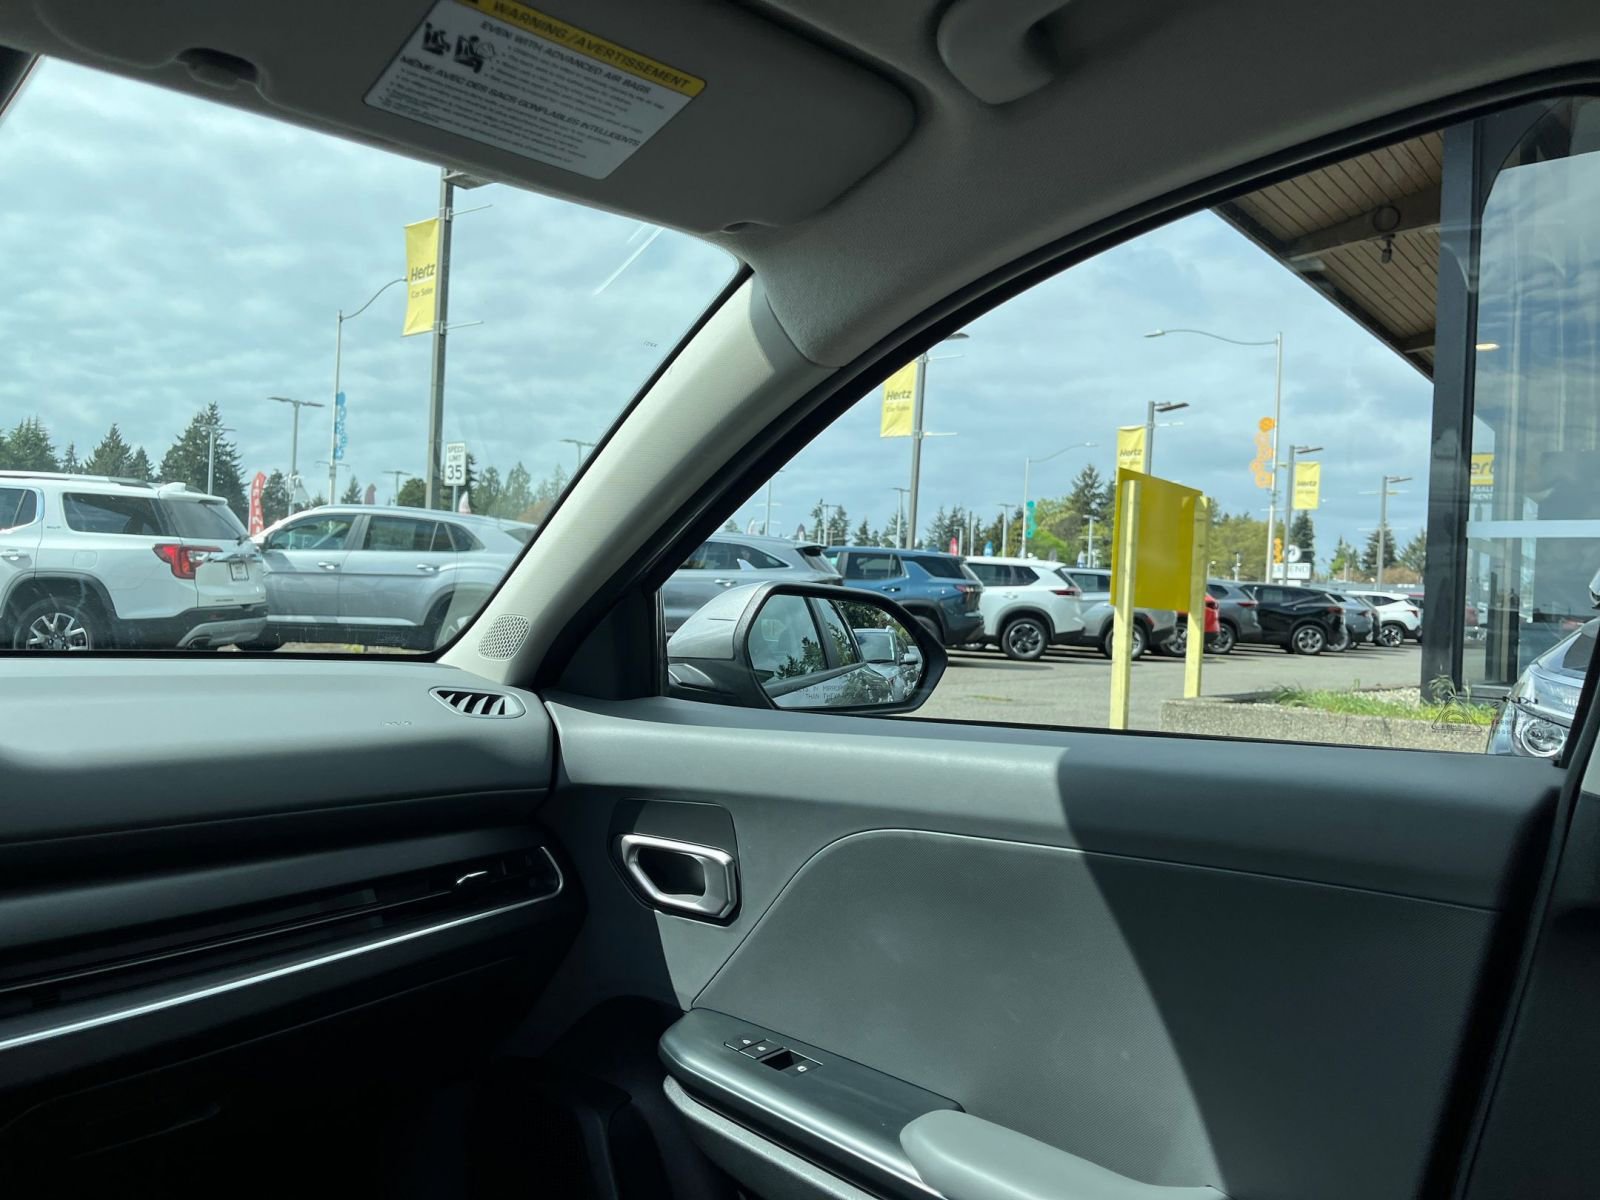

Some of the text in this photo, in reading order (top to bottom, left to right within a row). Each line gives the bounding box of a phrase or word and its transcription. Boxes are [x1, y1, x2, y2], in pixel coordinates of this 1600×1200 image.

[480, 21, 511, 39] EVEN
[514, 34, 542, 51] WITH
[543, 46, 603, 74] ADVANCED
[603, 70, 621, 81] AIR
[411, 263, 435, 281] Hertz
[886, 390, 912, 400] Hertz
[448, 454, 462, 462] LIMIT
[447, 464, 463, 480] 35
